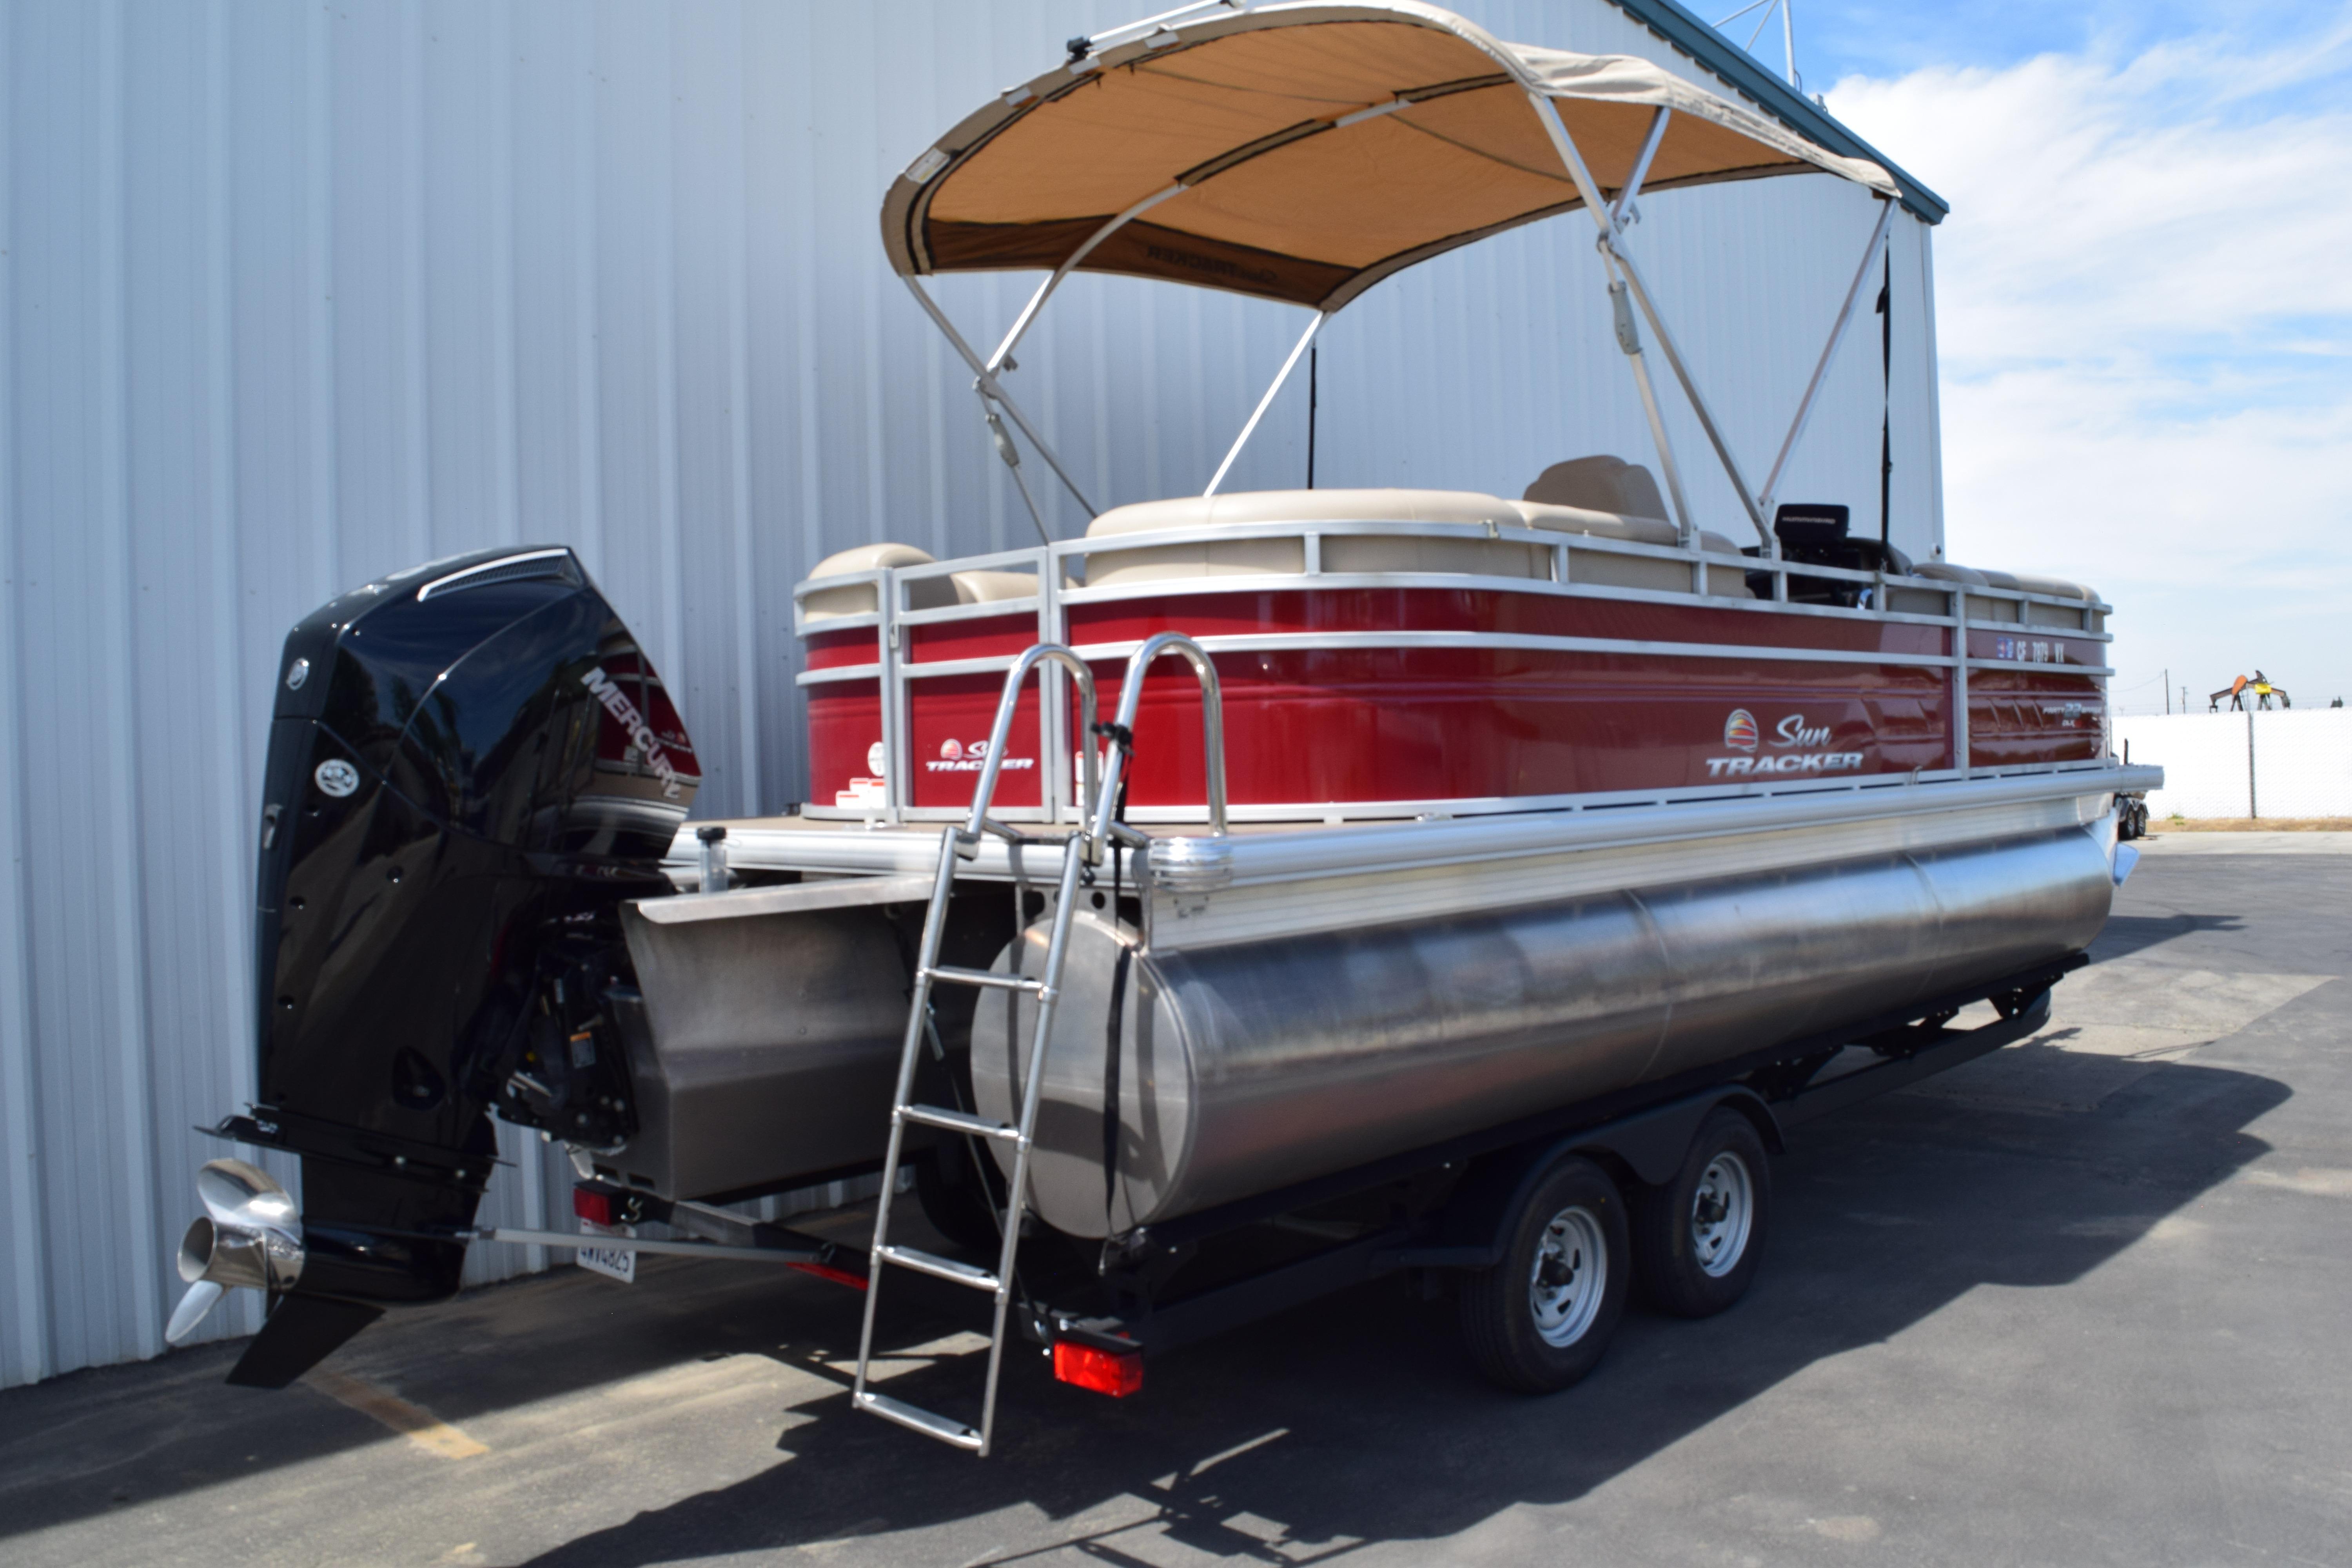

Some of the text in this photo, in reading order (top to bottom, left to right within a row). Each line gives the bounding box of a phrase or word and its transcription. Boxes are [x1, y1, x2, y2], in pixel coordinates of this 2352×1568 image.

[1768, 714, 1832, 748] Sun
[926, 758, 1034, 771] TRACER
[1706, 752, 1864, 777] TRACKER
